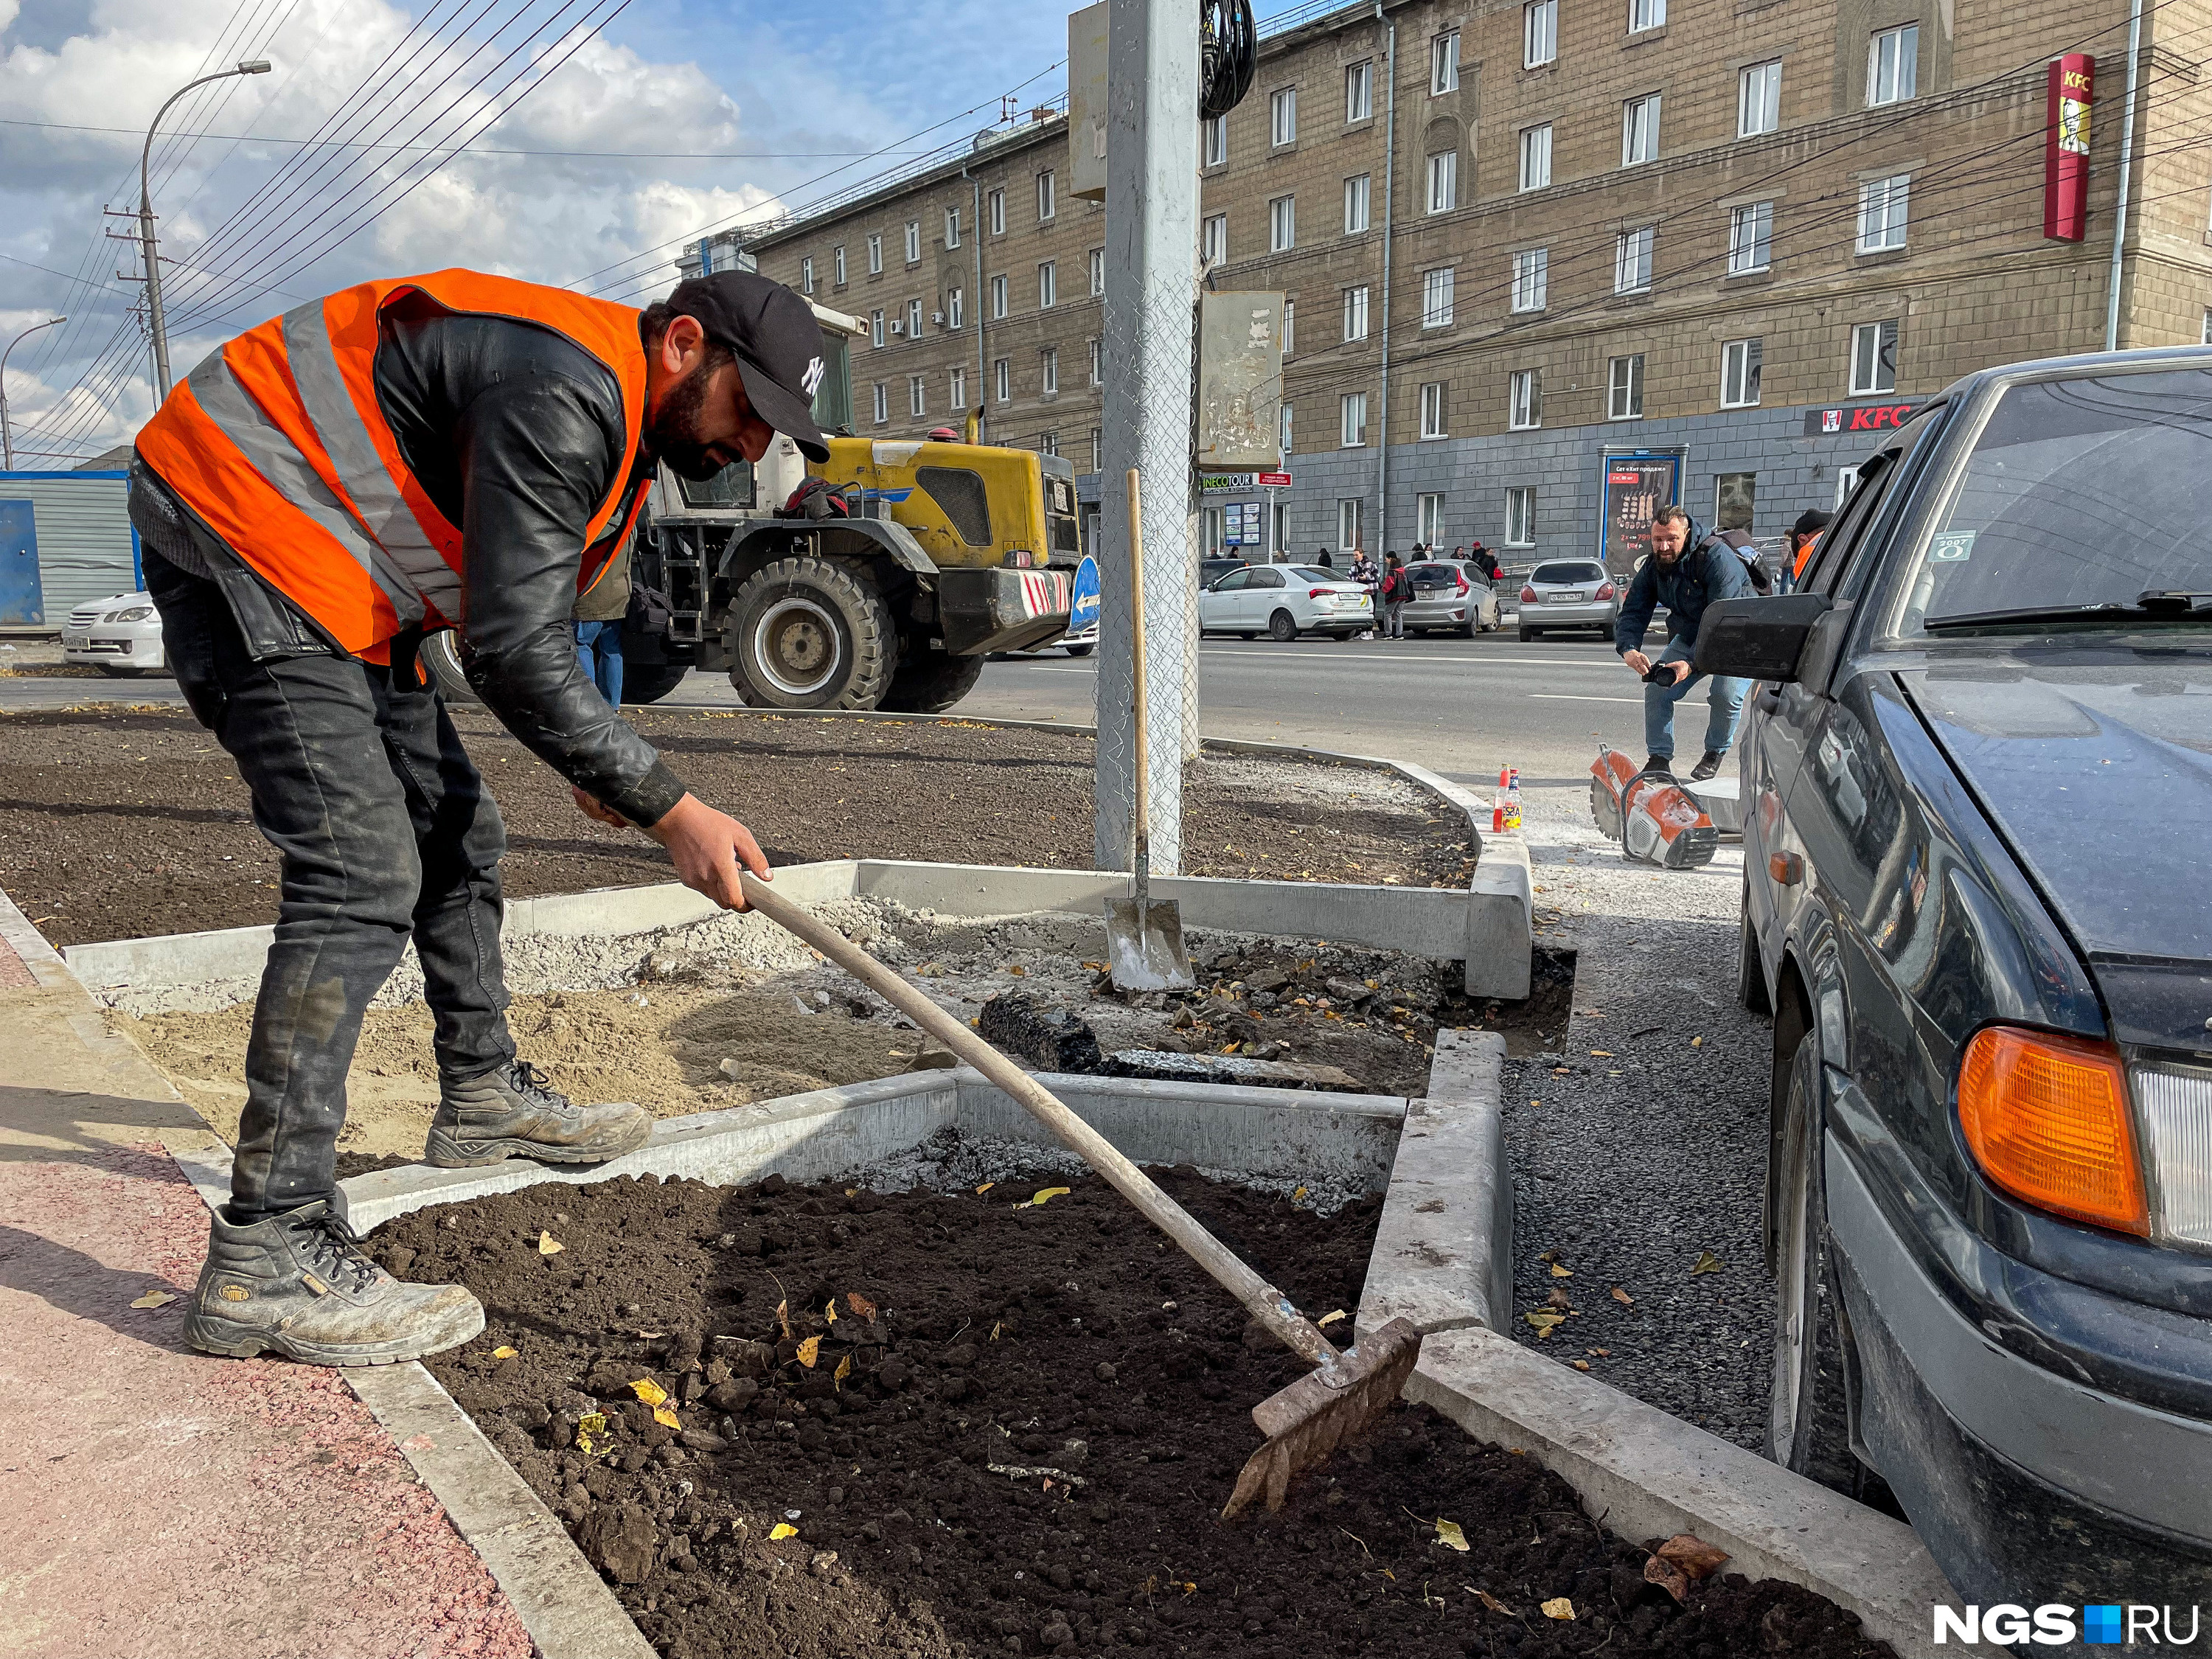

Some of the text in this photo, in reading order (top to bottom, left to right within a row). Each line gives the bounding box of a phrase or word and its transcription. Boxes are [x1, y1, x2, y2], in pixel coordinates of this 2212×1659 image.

[2064, 69, 2091, 92] KFC
[1849, 406, 1910, 430] KFC
[1203, 474, 1251, 487] INECOTOUR
